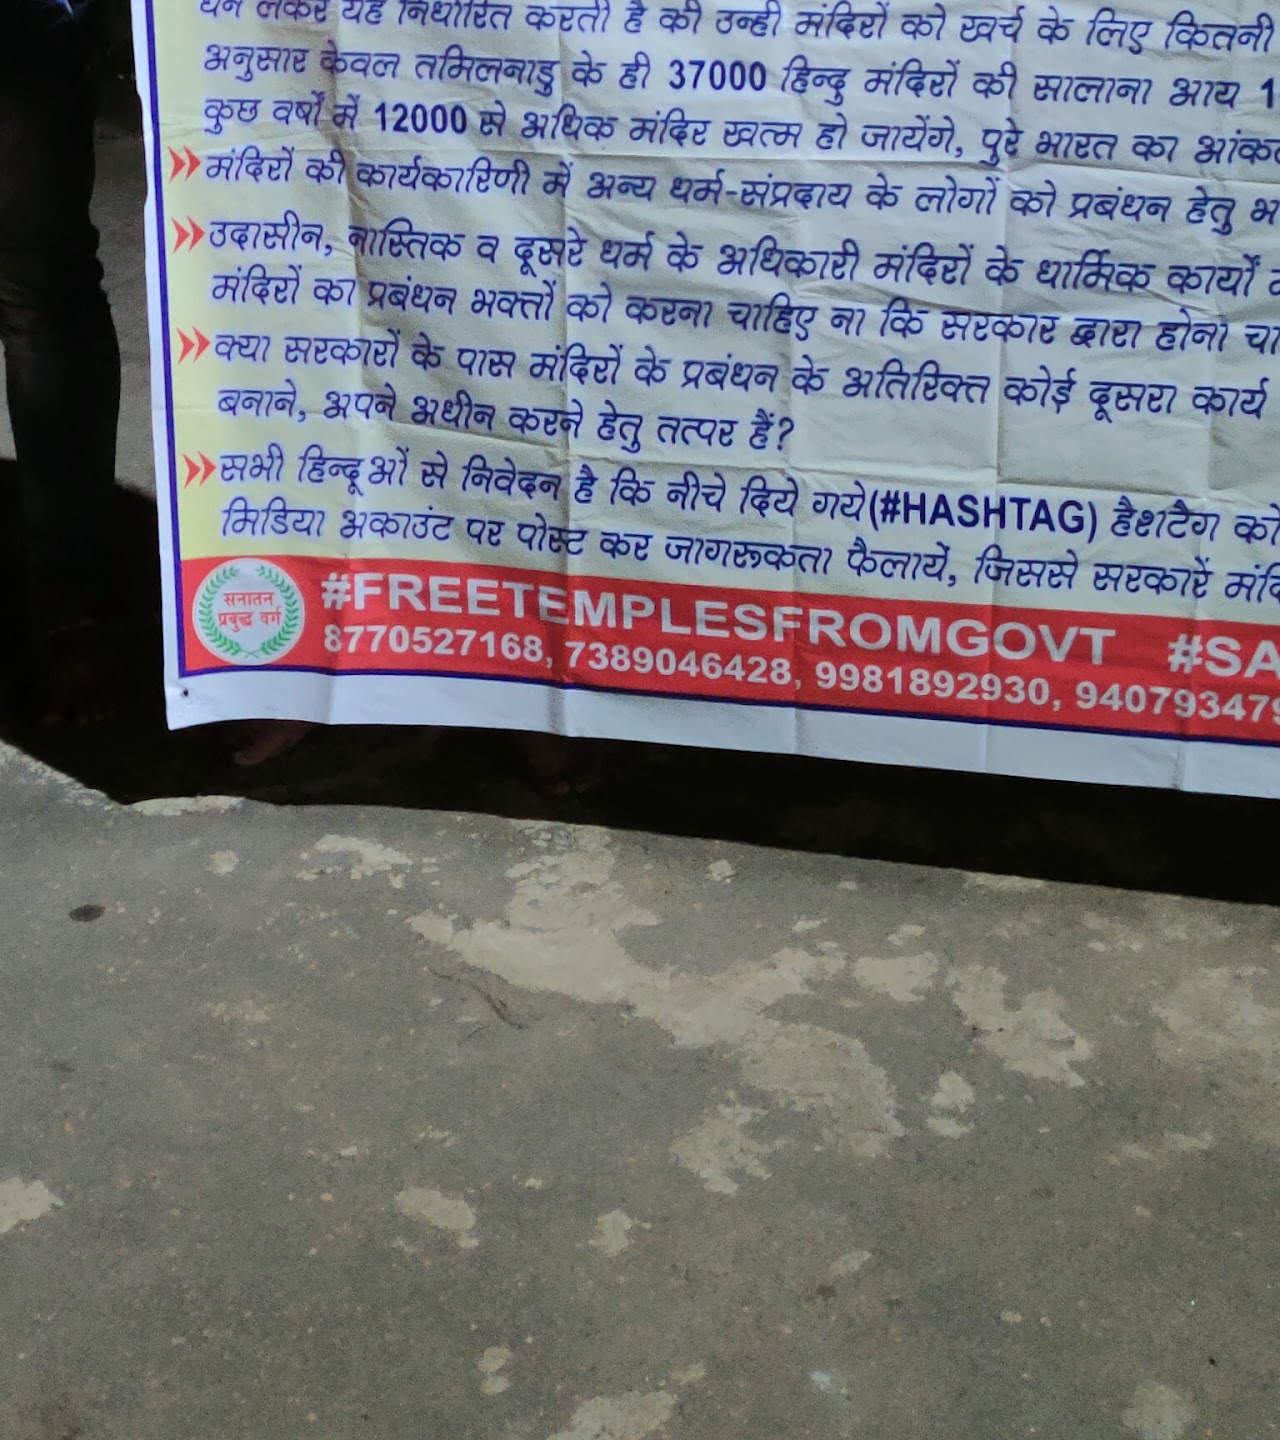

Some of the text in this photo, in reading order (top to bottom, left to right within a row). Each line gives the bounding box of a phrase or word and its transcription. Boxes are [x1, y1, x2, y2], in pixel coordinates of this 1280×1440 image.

[795, 0, 887, 39] मंदिरों
[960, 6, 1025, 43] खर्च
[1087, 7, 1152, 55] लिए
[1165, 10, 1275, 53] कितनी
[204, 44, 309, 82] अनुसार
[321, 40, 400, 77] केवल
[415, 45, 561, 98] तमिलनाडु
[669, 59, 767, 91] 37000
[864, 58, 960, 98] मंदिरों
[1034, 75, 1152, 104] सालाना
[204, 99, 262, 134] कुछ
[375, 102, 468, 134] 12000
[520, 103, 618, 141] अधिक
[629, 107, 712, 147] मंदिर
[724, 121, 803, 148] खत्म
[861, 115, 963, 164] जायेंगे,
[979, 117, 1024, 171] पुरे
[1036, 131, 1118, 161] भारत
[206, 145, 295, 182] मंदिरों
[356, 155, 530, 195] कार्यकारिणी
[587, 172, 656, 202] अन्य
[915, 175, 1000, 215] लोगों
[1069, 186, 1172, 222] प्रबंधन
[1186, 186, 1236, 236] हेतु
[210, 210, 333, 256] उदासीन,
[348, 217, 465, 261] नास्तिक
[515, 226, 589, 278] दूसरे
[600, 230, 655, 271] धर्म
[717, 235, 860, 281] अधिकारी
[874, 242, 974, 286] मंदिरों
[1037, 249, 1156, 296] धार्मिक
[1167, 253, 1261, 297] कार्यों
[212, 264, 302, 305] मंदिरों
[367, 276, 457, 315] प्रबंधन
[471, 280, 556, 321] भक्तों
[625, 295, 713, 328] करना
[728, 292, 819, 341] चाहिए
[941, 308, 1060, 345] सरकार
[1070, 318, 1143, 348] द्वारा
[1156, 305, 1232, 352] होना
[215, 335, 270, 362] क्या
[285, 328, 401, 368] सरकारों
[458, 348, 516, 378] पास
[530, 342, 623, 385] मंदिरों
[681, 354, 779, 392] प्रबंधन
[842, 357, 990, 404] अतिरिक्त
[1003, 365, 1077, 414] कोई
[1089, 381, 1177, 423] दूसरा
[1192, 377, 1270, 420] कार्य
[218, 379, 738, 453] बनाने, अपने अधीन करने हेतु तत्पर
[220, 443, 284, 482] सभी
[462, 454, 562, 501] निवेदन
[667, 470, 726, 513] नीचे
[740, 475, 798, 518] दिये
[1111, 496, 1220, 541] हैशटैग
[223, 496, 325, 536] मिडिया
[340, 505, 455, 541] अकाउंट
[517, 512, 589, 555] पोस्ट
[665, 536, 832, 575] जागरूकता
[974, 543, 1079, 589] जिससे
[1093, 556, 1214, 599] सरकारें
[223, 591, 274, 607] सनातन
[260, 606, 281, 626] वर्ग
[321, 572, 1116, 665] #FREETEMPLESFROMGOVT
[324, 624, 553, 669] 8770527168,
[564, 641, 801, 690] 7389046428,
[815, 660, 1061, 711] 9981892930,
